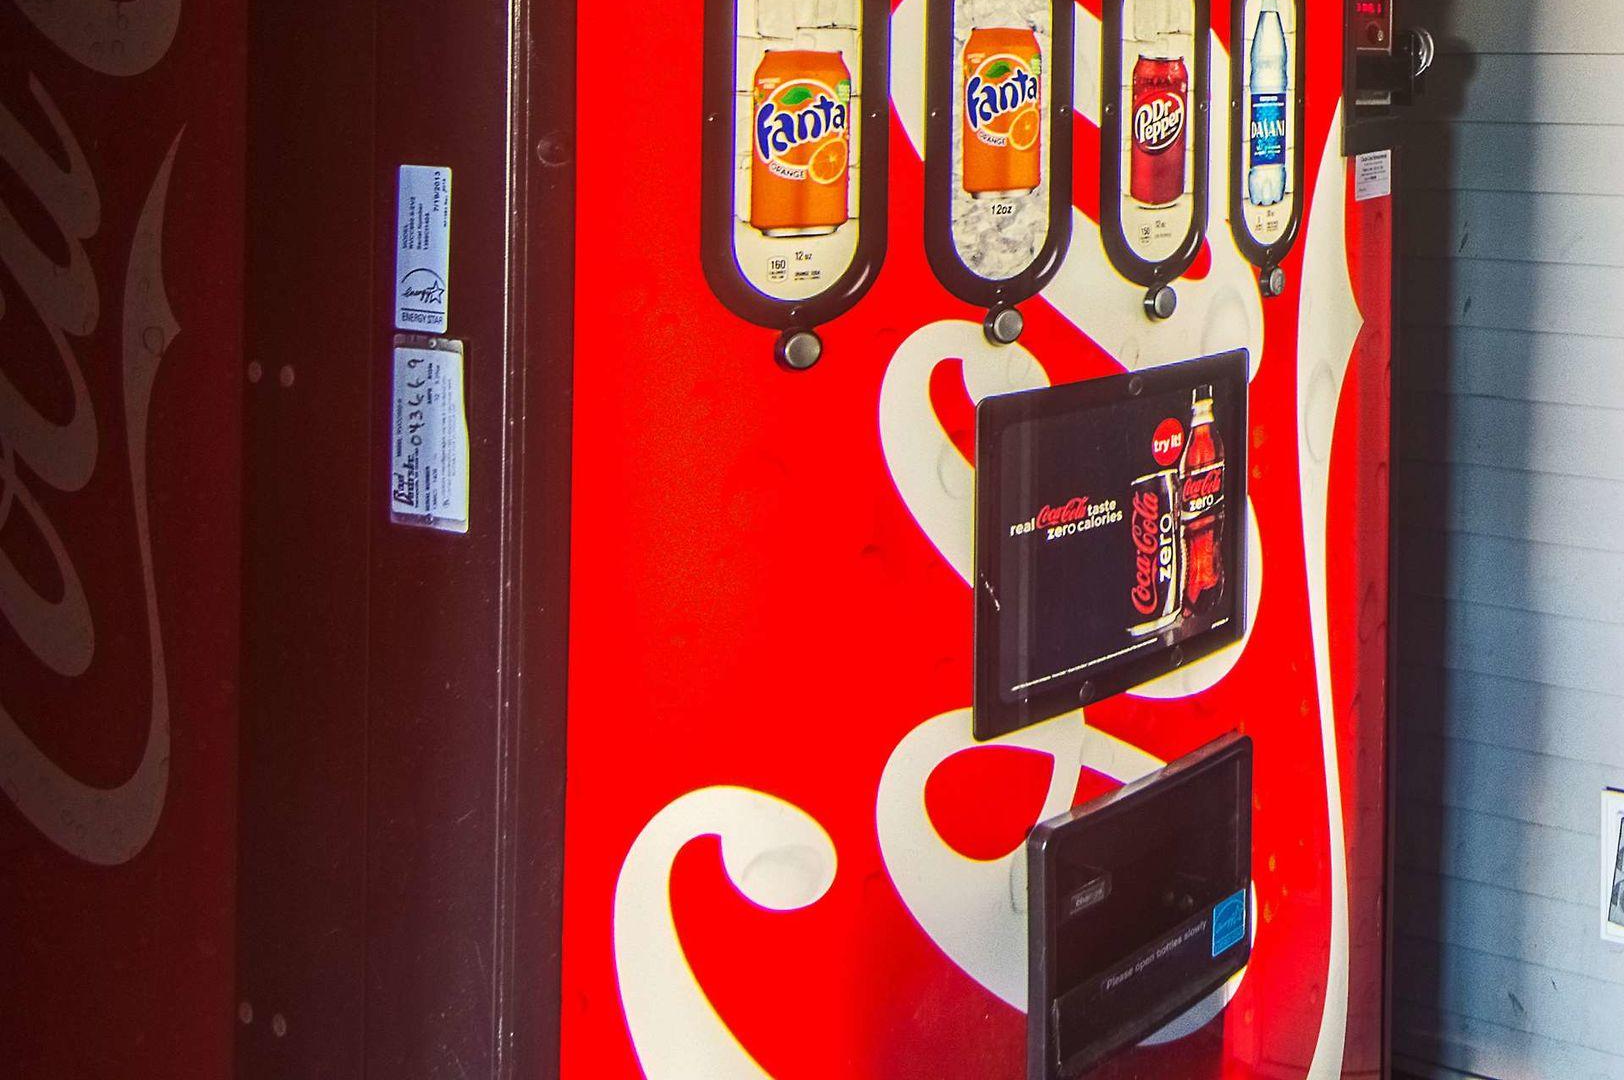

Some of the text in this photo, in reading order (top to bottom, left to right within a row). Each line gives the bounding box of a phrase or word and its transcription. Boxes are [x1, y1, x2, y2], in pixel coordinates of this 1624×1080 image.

[967, 69, 1038, 129] Fanta
[1152, 98, 1173, 120] Dr
[757, 95, 846, 160] Fanta
[1135, 104, 1182, 144] Pepper
[1251, 119, 1285, 139] DASANI
[769, 162, 805, 179] ORANGE
[991, 203, 1012, 214] 12oz
[771, 260, 786, 270] 160
[1154, 432, 1182, 454] try it!
[1183, 468, 1222, 502] Coca-Cola
[1010, 496, 1117, 537] real Coca-Cola taste
[1189, 493, 1214, 512] zero
[1047, 509, 1123, 541] zero calories
[1131, 491, 1159, 615] Coca-Cola
[1159, 512, 1173, 582] zero
[1106, 966, 1134, 990] Please
[1155, 936, 1183, 959] bottles
[1183, 919, 1208, 941] slowly
